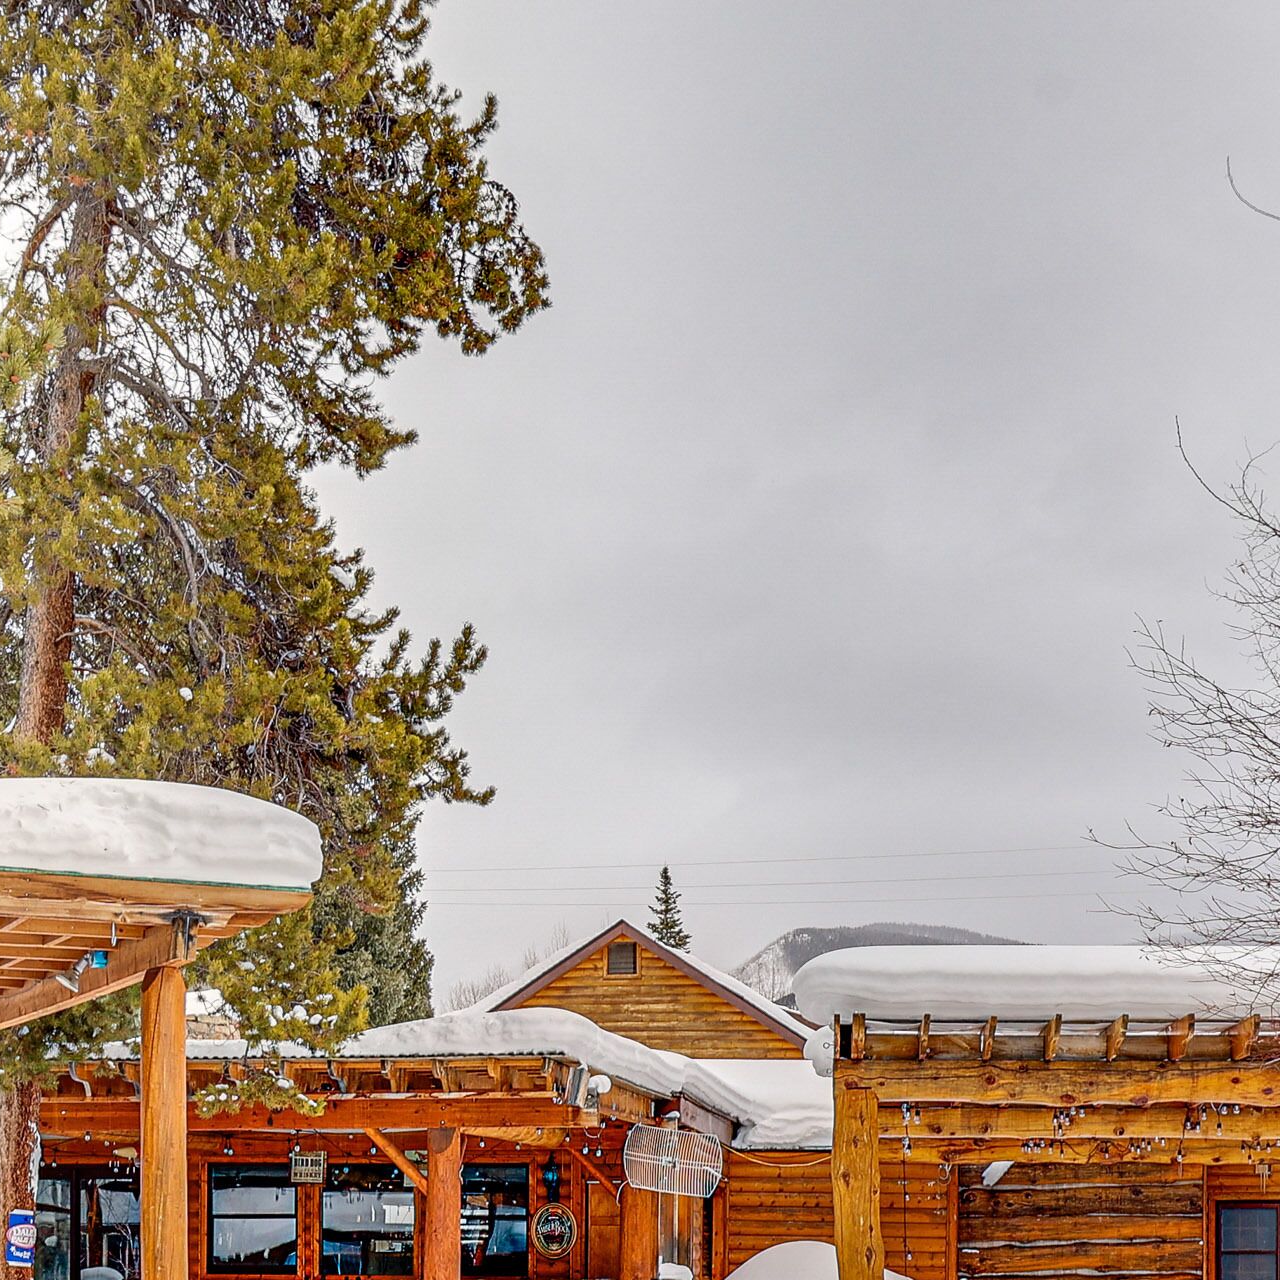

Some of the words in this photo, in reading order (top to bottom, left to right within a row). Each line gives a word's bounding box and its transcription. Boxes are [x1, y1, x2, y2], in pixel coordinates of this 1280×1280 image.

[294, 1158, 309, 1167] BIRD
[310, 1158, 322, 1167] DOG
[293, 1171, 322, 1179] WHISKEY
